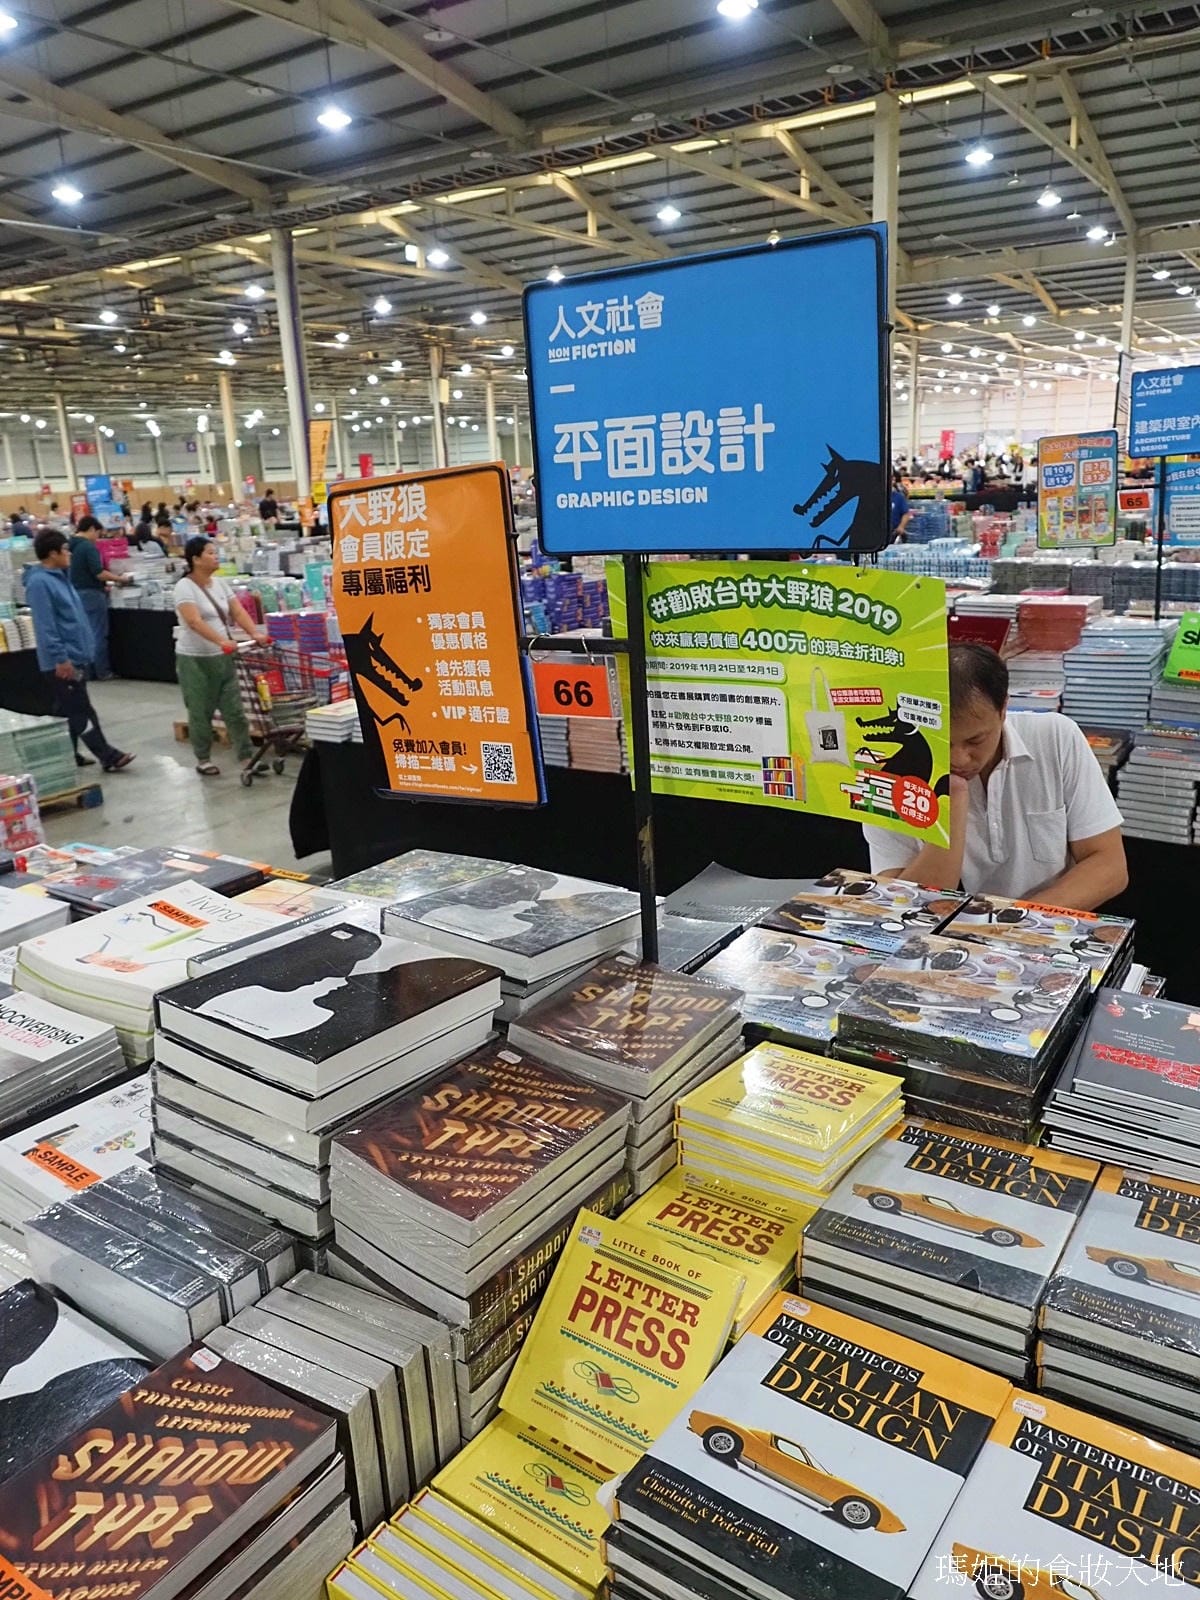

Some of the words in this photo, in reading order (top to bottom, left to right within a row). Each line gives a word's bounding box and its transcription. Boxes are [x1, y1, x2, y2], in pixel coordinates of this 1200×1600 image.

[548, 291, 664, 342] 人文社會
[548, 348, 570, 361] NON
[572, 338, 636, 361] FICTION
[1136, 374, 1184, 390] 人文社會
[553, 403, 775, 480] 平面設計
[1141, 444, 1168, 452] DESIGN
[339, 483, 428, 528] 大野狼
[556, 489, 635, 509] GRAPHIC
[638, 486, 708, 507] DESIGN
[1126, 497, 1143, 507] 65
[339, 528, 430, 564] 會員限定
[341, 565, 431, 596] 專屬福利
[427, 611, 486, 630] 獨家會員
[431, 632, 488, 650] 優惠價格
[435, 659, 491, 677] 搶先獲得
[646, 661, 668, 671] 期間:
[438, 679, 494, 697] 活動訊息
[553, 679, 594, 707] 66
[441, 706, 467, 719] VIP
[468, 706, 510, 724] 通行證
[392, 738, 467, 756] 免費加入會員!
[395, 753, 456, 772] 掃描二維碼
[902, 790, 930, 813] 20
[159, 904, 201, 926] SAMPLE
[187, 895, 243, 923] living
[572, 983, 727, 1013] SHADOW
[588, 1006, 694, 1032] TYPE
[493, 1061, 544, 1079] CLASSIC
[766, 1060, 866, 1093] LETTER
[490, 1081, 566, 1100] LETTERING
[421, 1083, 605, 1130] SHADOW
[424, 1119, 554, 1159] TYPE
[900, 1135, 925, 1146] OF
[905, 1127, 1032, 1164] MASTERPIECES
[38, 1148, 90, 1183] SAMPLE
[398, 1152, 469, 1168] STEVEN
[472, 1158, 536, 1173] HELLER
[408, 1169, 450, 1182] AND
[919, 1141, 1072, 1192] ITALIAN
[704, 1182, 737, 1196] LITTLE
[741, 1195, 769, 1208] BOOK
[909, 1155, 1065, 1208] DESIGN
[1120, 1188, 1146, 1199] OF
[675, 1191, 785, 1237] LETTER
[656, 1202, 775, 1256] PRESS
[612, 1238, 647, 1258] LITTLE
[651, 1254, 681, 1273] BOOK
[687, 1269, 702, 1280] OF
[585, 1260, 700, 1329] LETTER
[567, 1285, 691, 1371] PRESS
[767, 1328, 796, 1347] OF
[777, 1315, 921, 1384] MASTERPIECES
[171, 1378, 234, 1397] CLASSIC
[785, 1341, 968, 1433] ITALIAN
[134, 1389, 294, 1420] THREE-DIMENSIONAL
[765, 1367, 952, 1461] DESIGN
[156, 1415, 252, 1434] LETTERING
[52, 1428, 295, 1487] SHADOW
[1015, 1436, 1048, 1460] OF
[1021, 1419, 1200, 1505] MASTERPIECES
[650, 1469, 685, 1491] Foreword
[686, 1484, 694, 1497] by
[697, 1494, 726, 1513] Michele
[33, 1490, 214, 1551] TYPE
[642, 1475, 698, 1511] Charlotte
[697, 1507, 710, 1519] &
[710, 1513, 746, 1539] Peter
[746, 1533, 780, 1557] Fiell
[86, 1556, 169, 1576] HELLER
